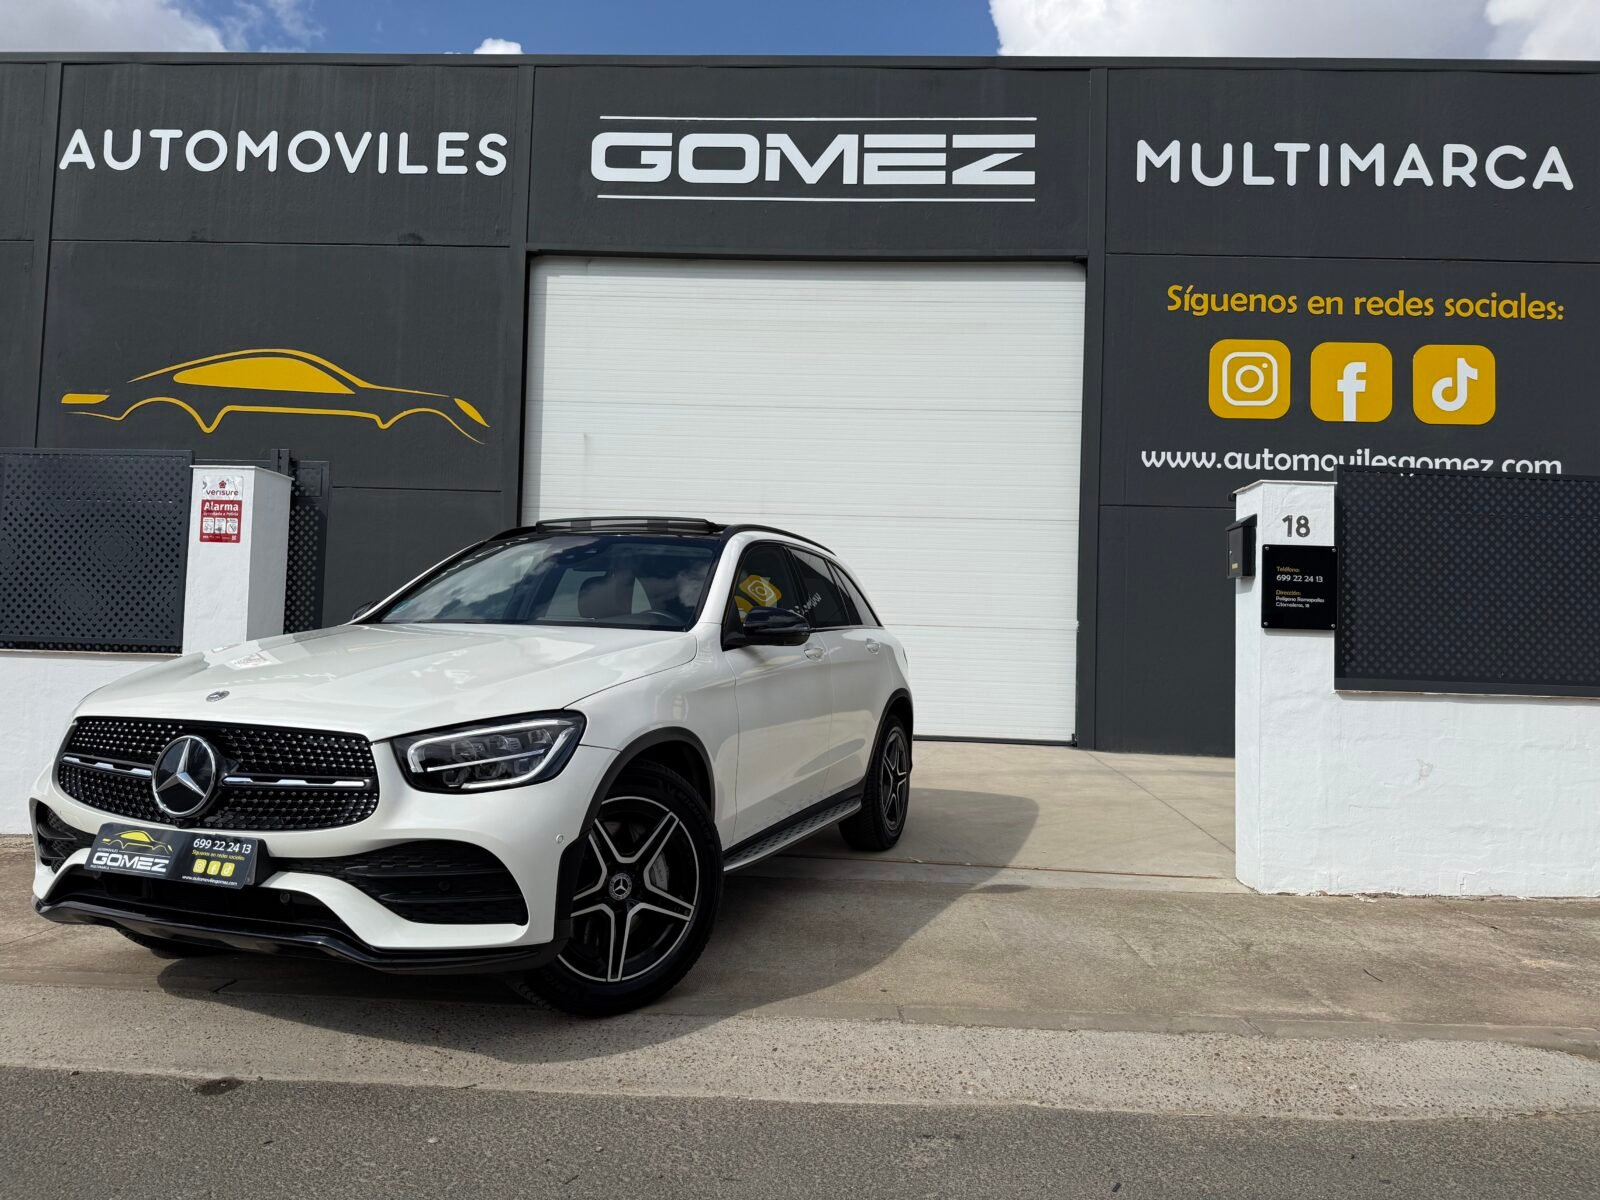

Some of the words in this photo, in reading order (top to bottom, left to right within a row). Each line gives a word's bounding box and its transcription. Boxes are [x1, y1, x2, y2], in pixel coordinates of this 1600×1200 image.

[59, 128, 508, 177] AUTOMOVILES
[591, 131, 1036, 185] GOMEZ
[1136, 139, 1574, 191] MULTIMARCA
[1167, 284, 1298, 317] Síguenos
[1307, 297, 1345, 316] en
[1354, 290, 1435, 318] redes
[1444, 292, 1565, 321] sociales:
[1141, 448, 1562, 476] www.automovilesgomezcom
[204, 502, 239, 511] Alarma
[1282, 515, 1310, 538] 18
[1276, 574, 1291, 582] 699
[1304, 575, 1314, 583] 24
[193, 838, 212, 849] 699
[213, 840, 226, 851] 22
[227, 842, 240, 853] 24
[241, 844, 252, 854] 13
[92, 852, 170, 873] GOMEZ
